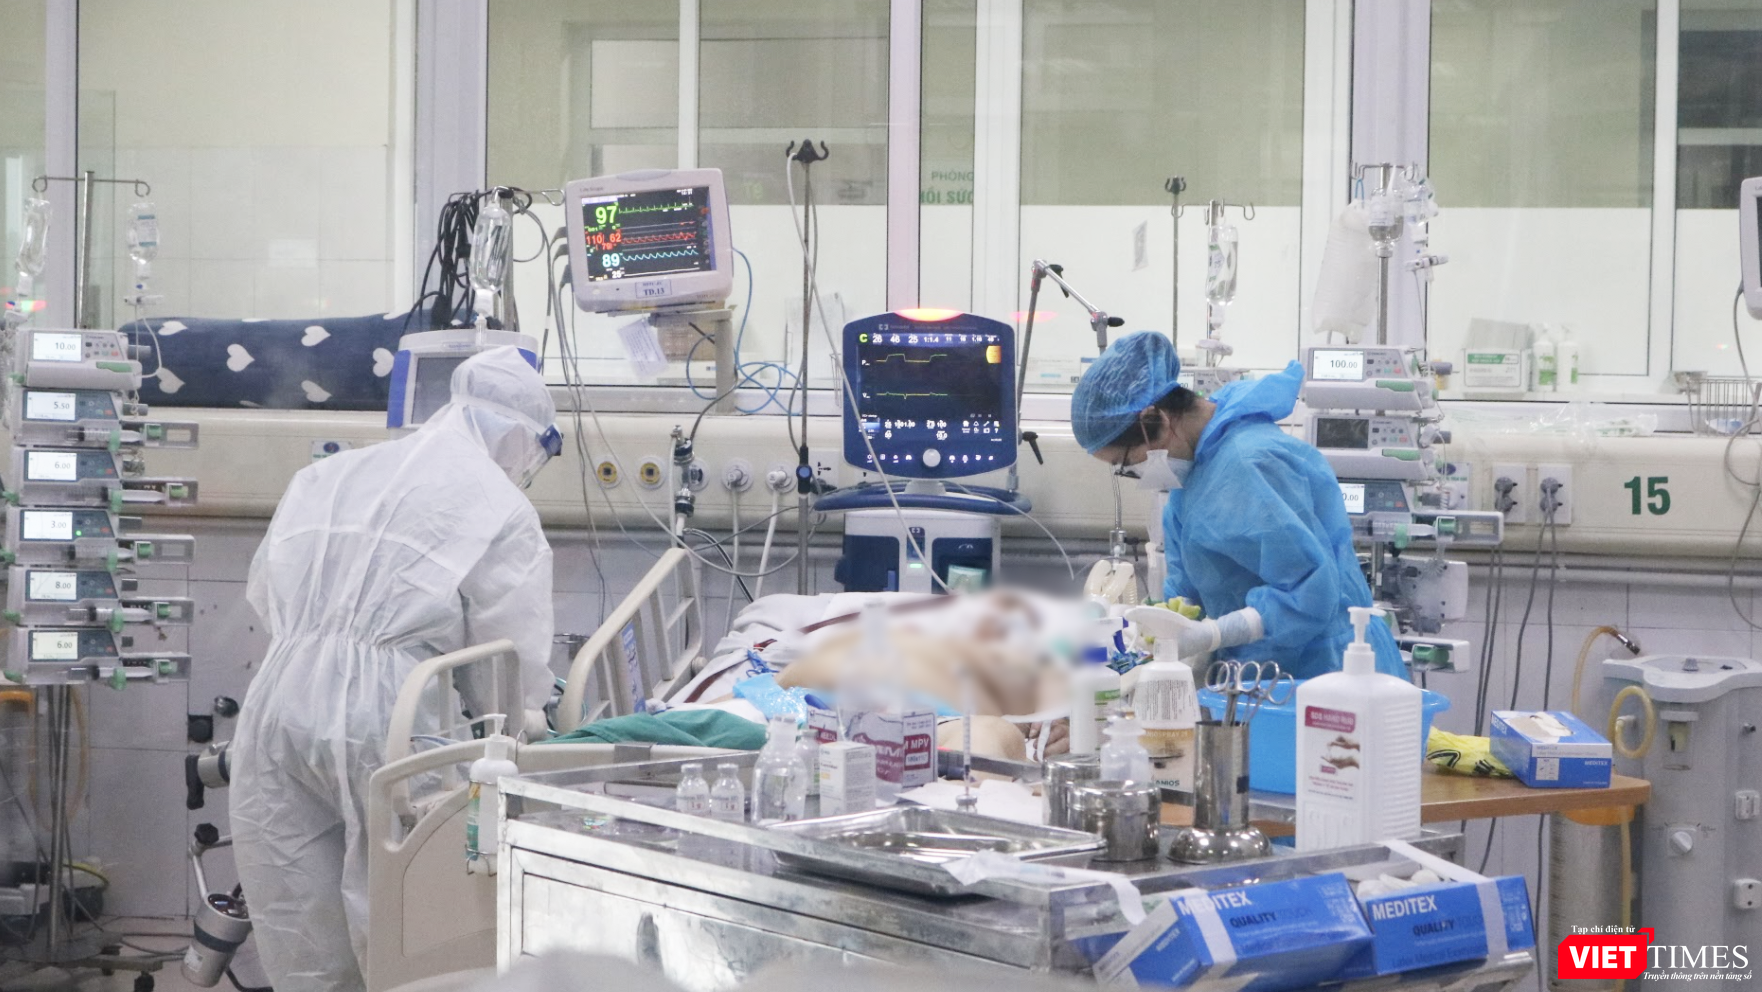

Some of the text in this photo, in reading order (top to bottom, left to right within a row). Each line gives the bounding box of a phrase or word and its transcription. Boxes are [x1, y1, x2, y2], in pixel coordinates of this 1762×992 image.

[595, 206, 617, 225] 97
[586, 233, 622, 244] 110 62
[602, 253, 620, 268] 89
[859, 333, 868, 343] C
[54, 342, 76, 350] 10.00
[1330, 360, 1358, 369] 100.00
[53, 401, 70, 410] 5.50
[54, 461, 71, 470] 6.00
[1624, 476, 1671, 515] 15
[51, 520, 67, 529] 3.00
[55, 581, 71, 590] 8.00
[57, 641, 73, 650] 6.00
[911, 738, 930, 751] MPV
[1372, 894, 1438, 922] MEDITEX
[1229, 912, 1277, 930] QUALITY
[1413, 919, 1455, 938] QUALITY
